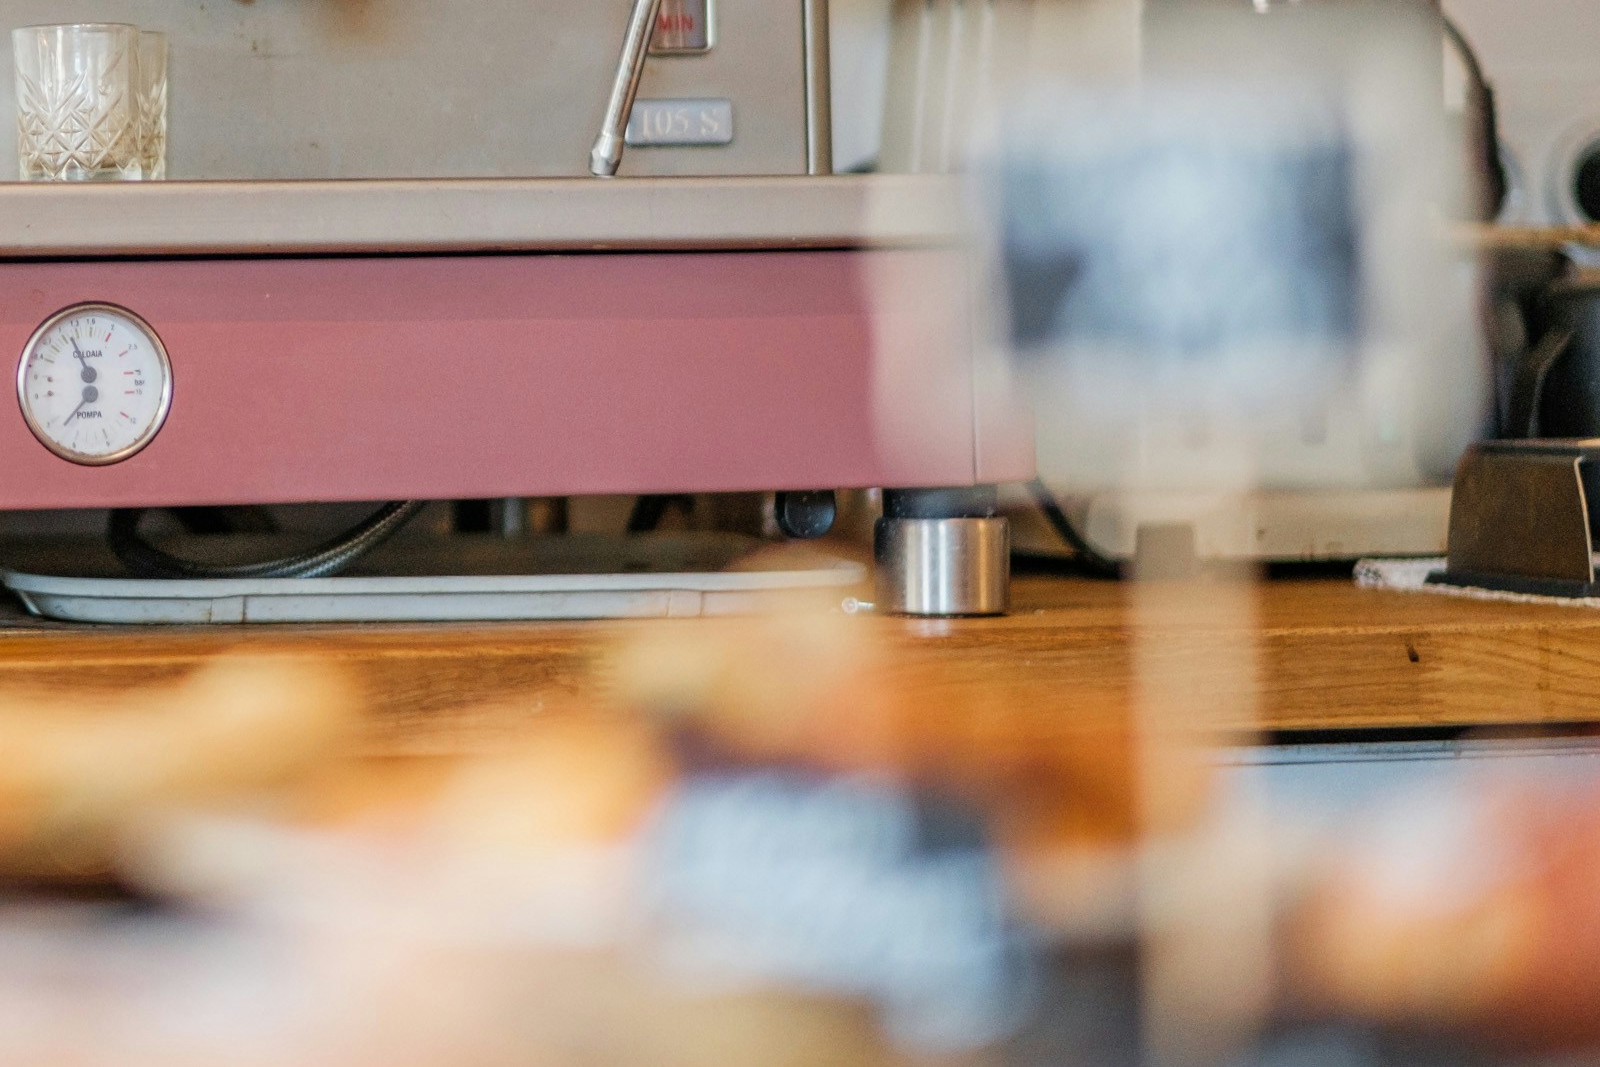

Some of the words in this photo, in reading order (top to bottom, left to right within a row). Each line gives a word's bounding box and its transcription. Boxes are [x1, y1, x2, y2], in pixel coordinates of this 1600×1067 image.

[658, 14, 693, 32] MIN
[641, 108, 689, 139] 105
[700, 108, 720, 135] S
[76, 410, 102, 420] POMPA
